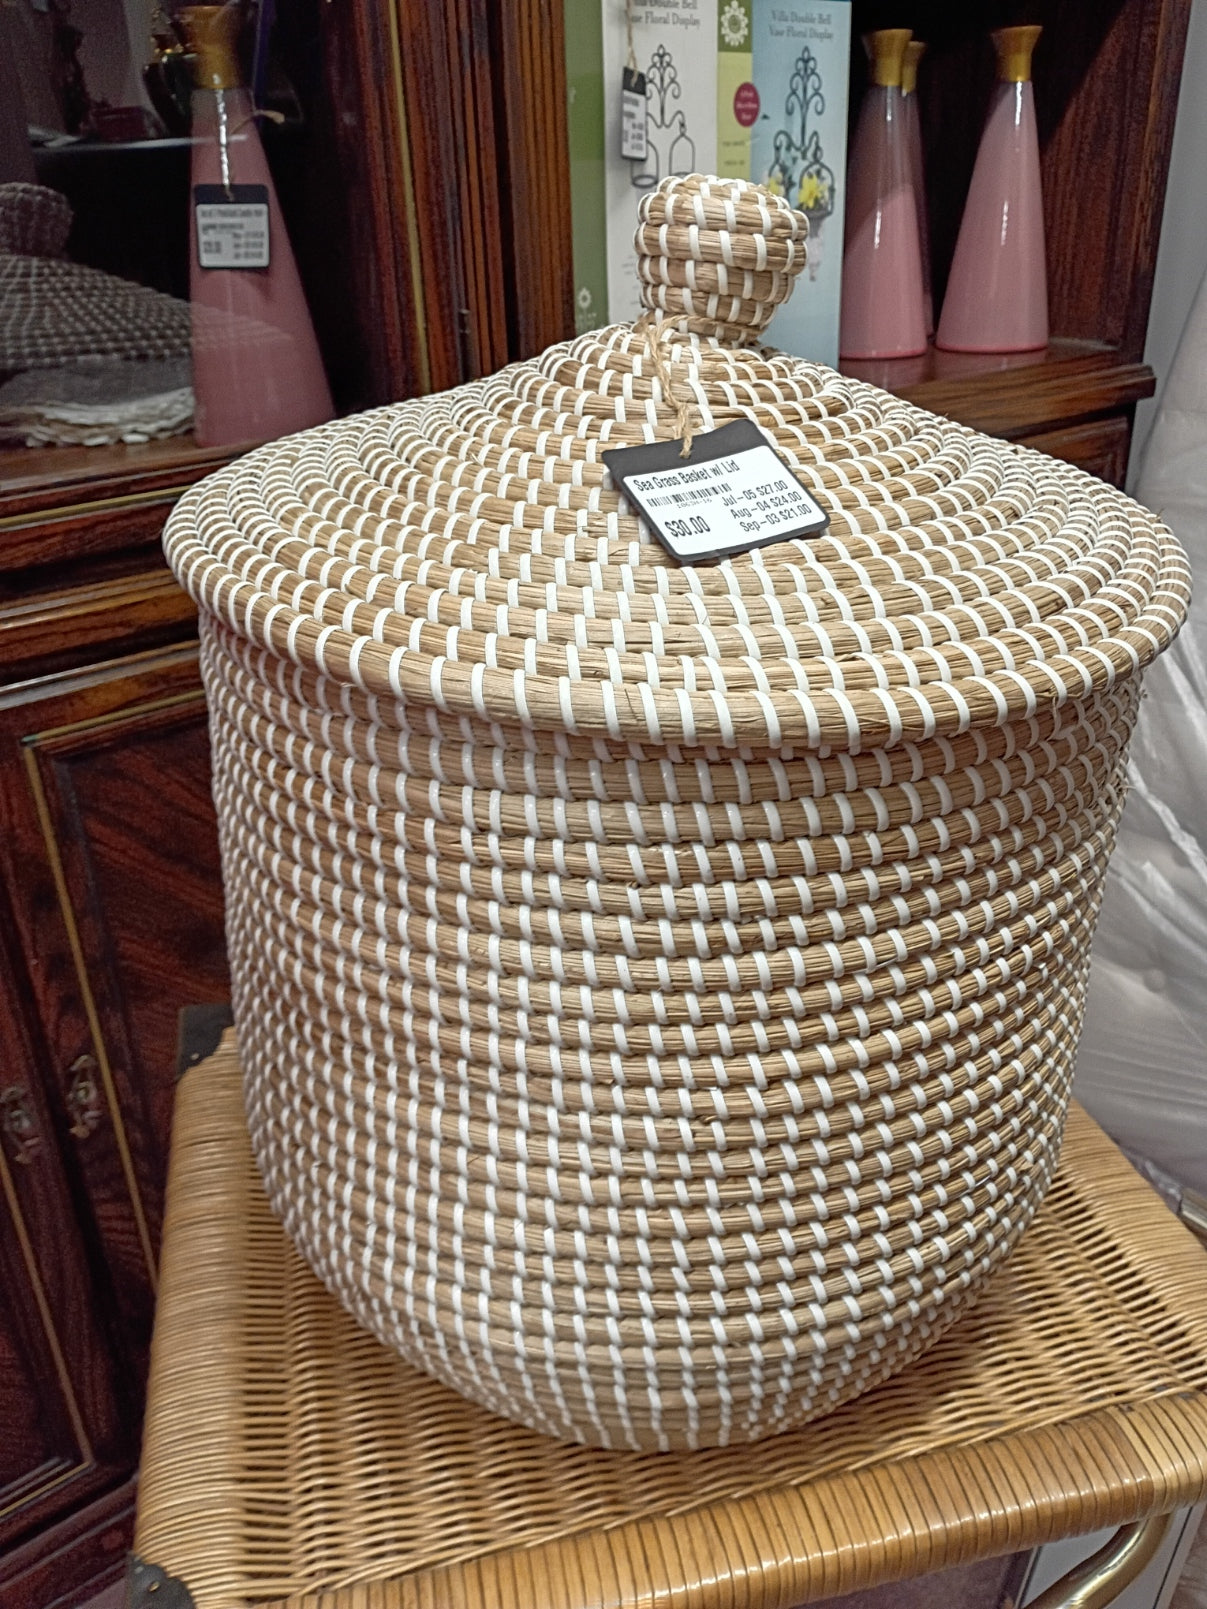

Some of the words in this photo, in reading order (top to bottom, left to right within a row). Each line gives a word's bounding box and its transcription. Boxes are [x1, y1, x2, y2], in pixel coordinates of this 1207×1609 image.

[645, 11, 670, 24] Floral
[672, 12, 700, 30] Display
[633, 479, 655, 492] Sea
[652, 476, 681, 489] Grass
[678, 469, 712, 484] Basket
[710, 464, 723, 477] w/
[721, 459, 740, 473] Lid
[756, 480, 788, 496] $27.00
[770, 491, 802, 508] $24.00
[779, 504, 812, 520] $21.00
[664, 516, 711, 538] $30.00
